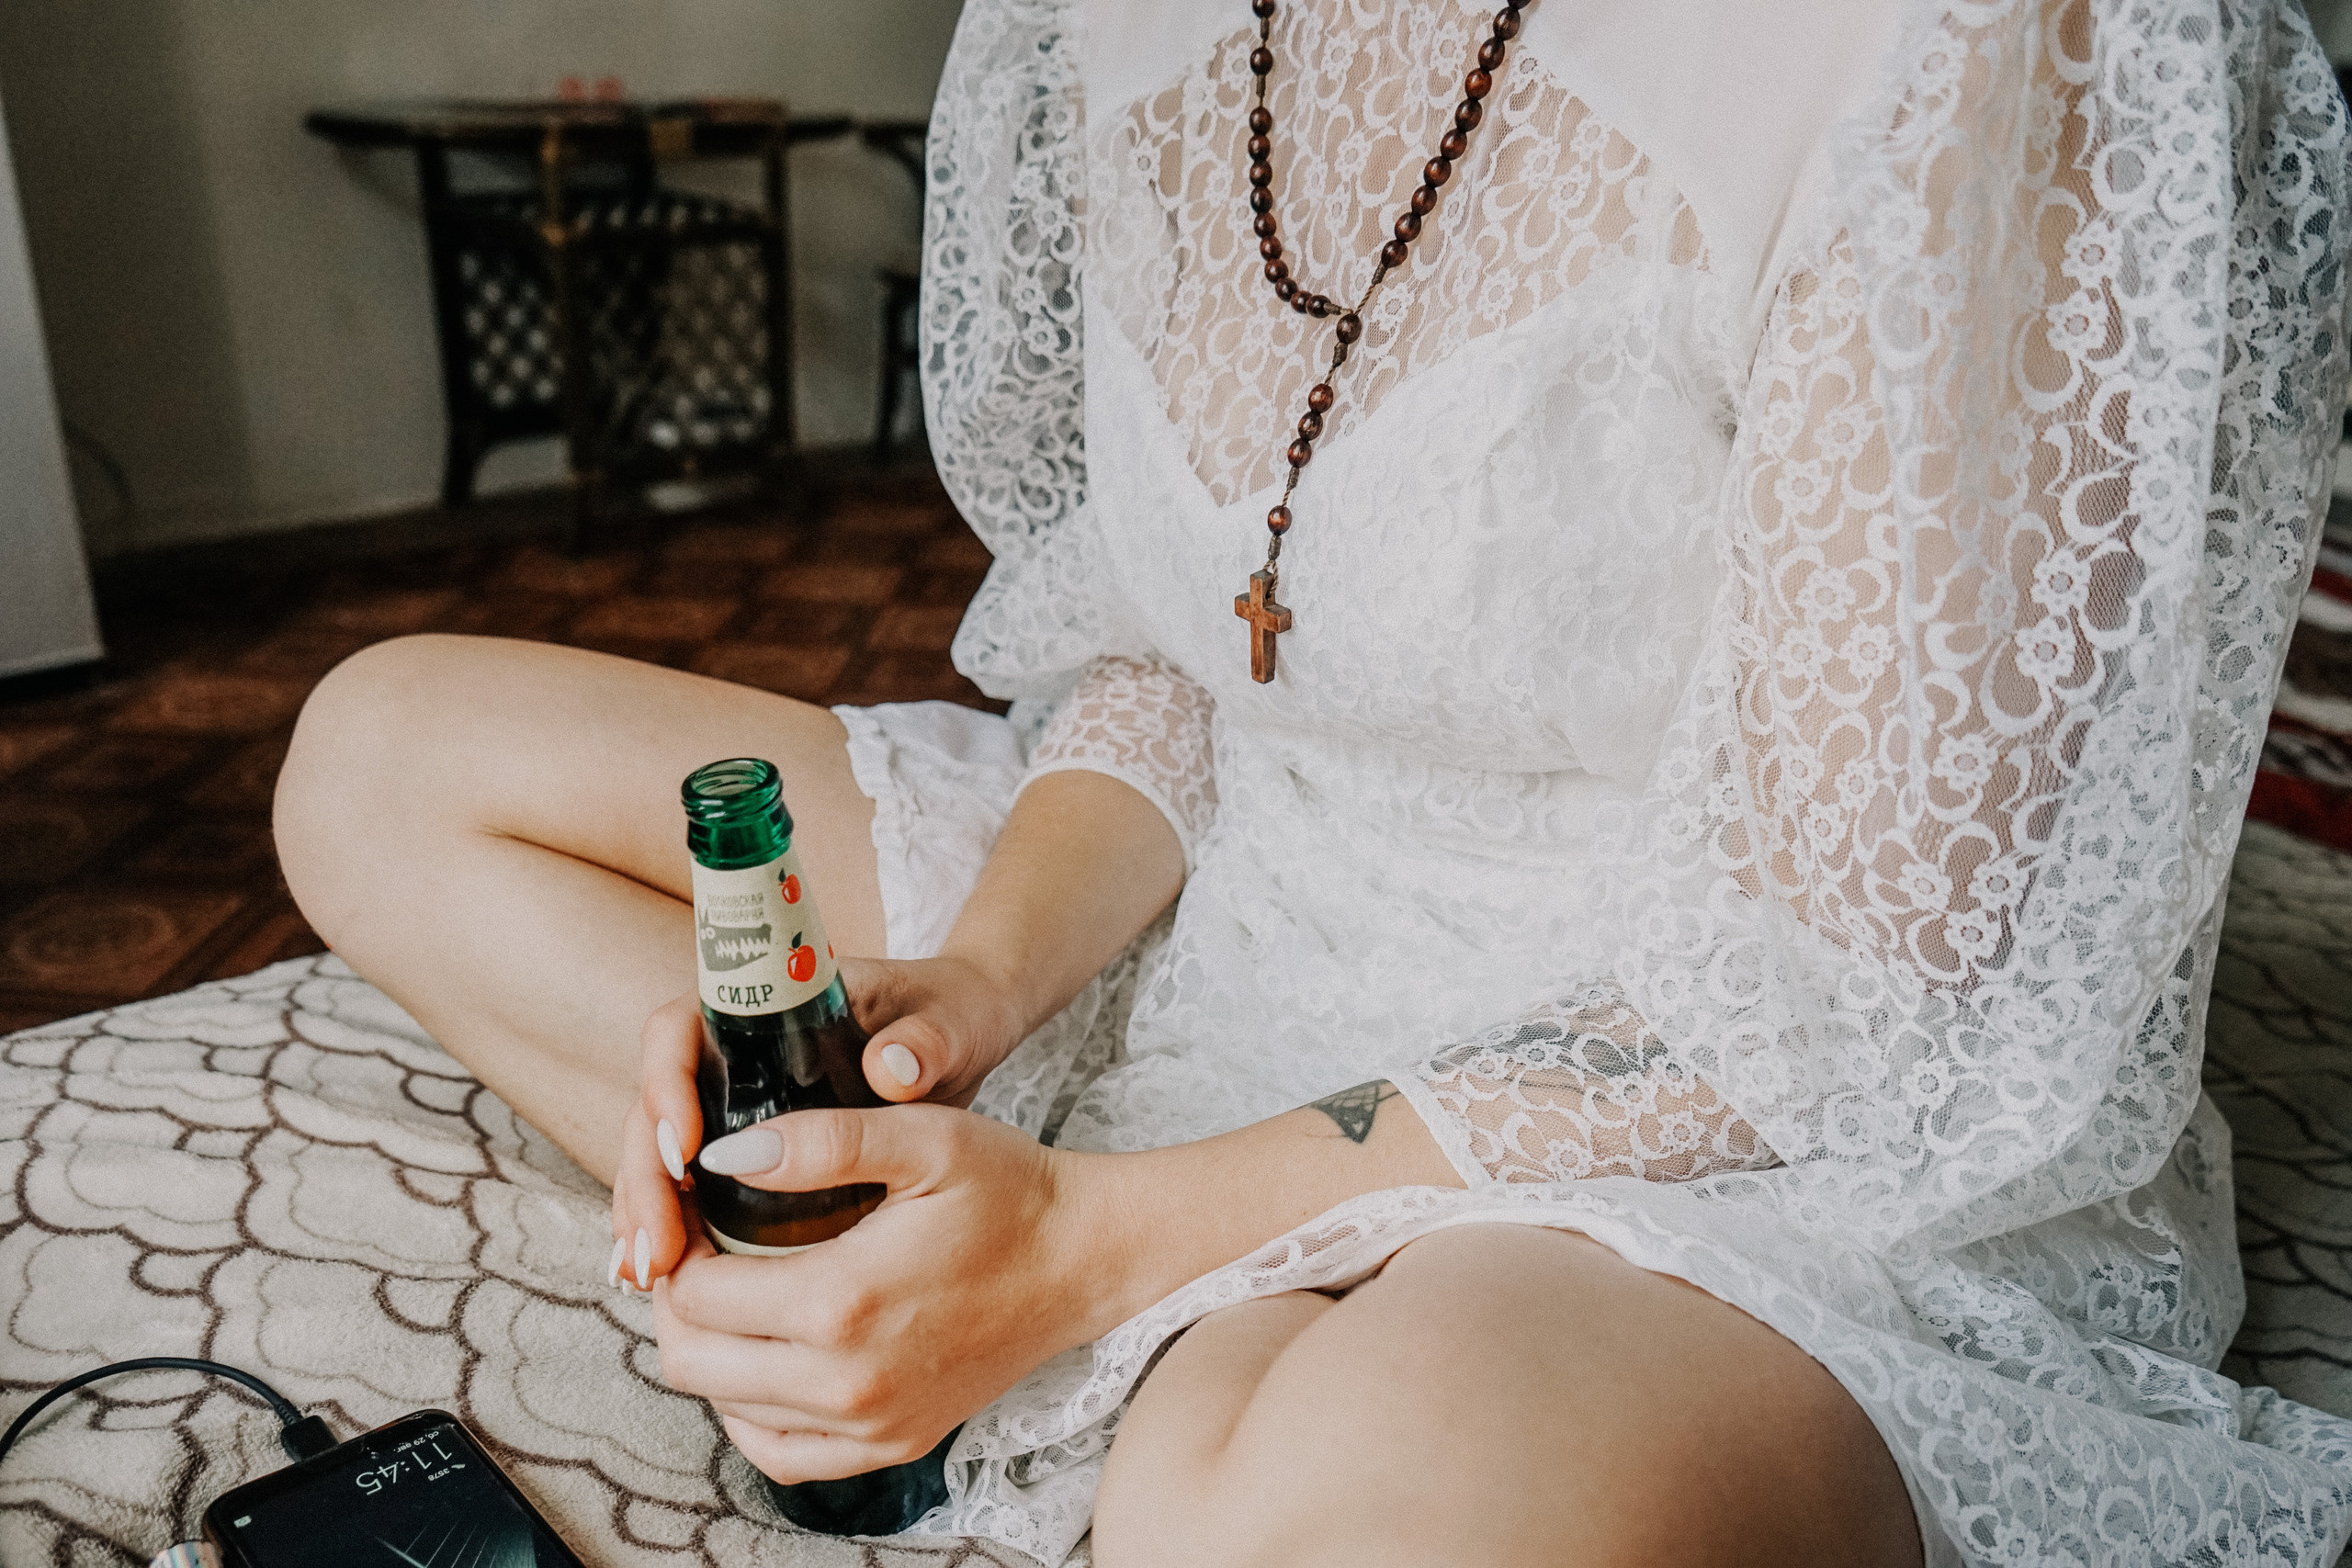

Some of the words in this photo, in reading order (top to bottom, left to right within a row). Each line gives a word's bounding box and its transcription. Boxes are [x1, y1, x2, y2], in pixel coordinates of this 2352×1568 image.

[718, 984, 774, 1008] СИДР
[413, 1436, 426, 1446] 29
[356, 1442, 453, 1495] 11:45
[427, 1468, 450, 1482] 3578
